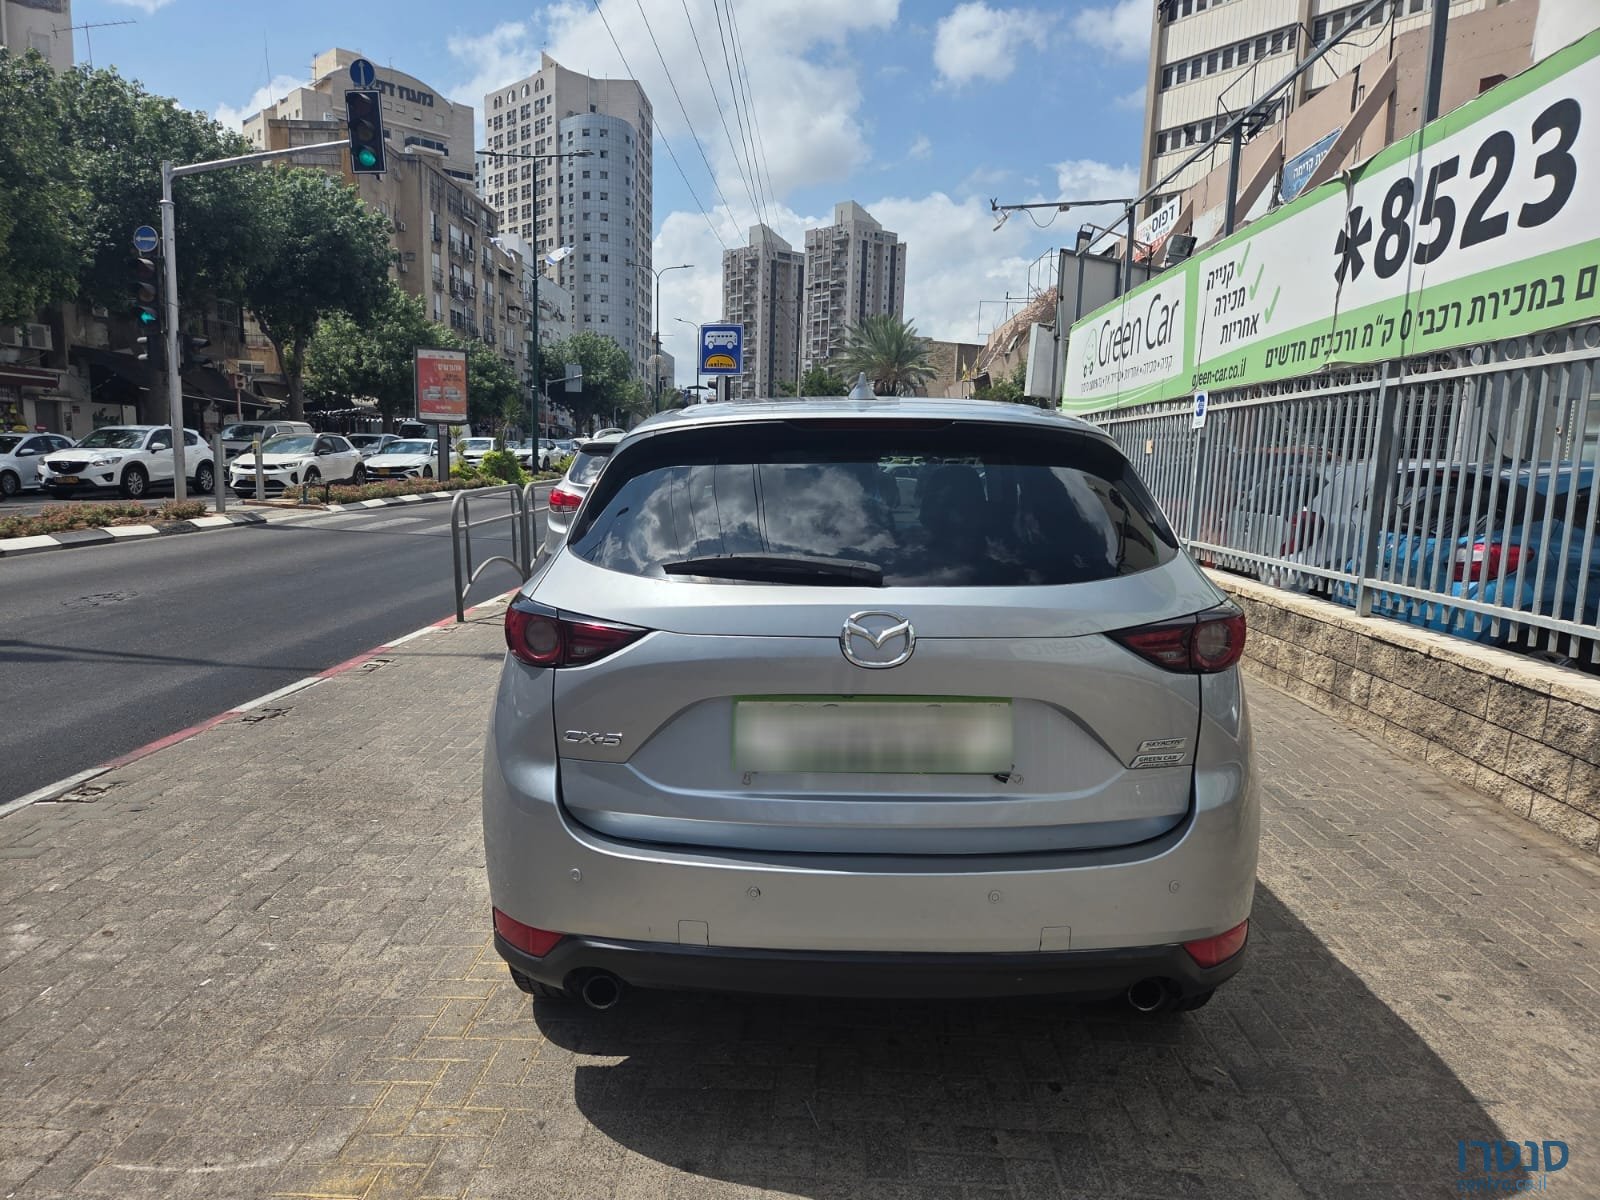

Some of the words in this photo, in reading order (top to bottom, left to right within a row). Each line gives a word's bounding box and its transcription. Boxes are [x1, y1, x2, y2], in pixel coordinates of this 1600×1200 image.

[1151, 204, 1175, 233] דפוס
[1206, 261, 1235, 292] קנייה
[1214, 286, 1246, 318] מכירה
[1467, 274, 1566, 326] במכירת
[1098, 317, 1142, 368] Green
[1145, 293, 1180, 350] Car
[1220, 313, 1260, 345] אחריות
[1400, 308, 1413, 341] 0
[1417, 301, 1462, 336] רכבי
[1265, 340, 1307, 369] חדשים
[1310, 327, 1358, 359] ורכבים
[563, 730, 623, 747] CX-5
